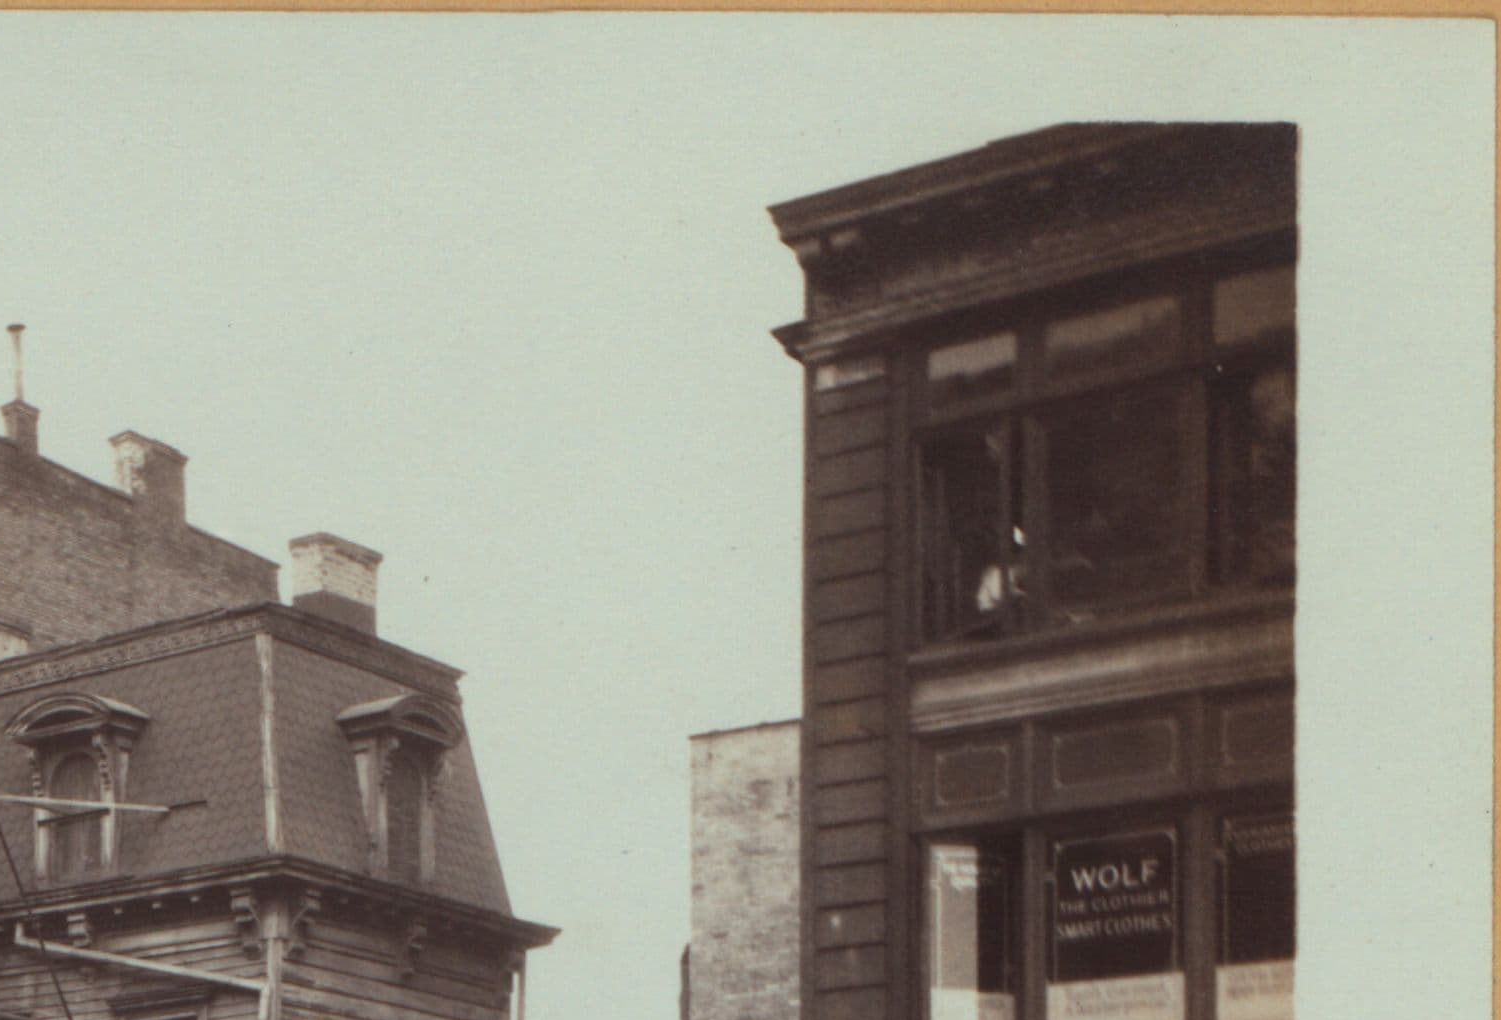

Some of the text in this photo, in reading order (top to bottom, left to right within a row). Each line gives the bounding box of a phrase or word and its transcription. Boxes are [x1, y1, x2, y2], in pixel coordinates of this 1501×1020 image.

[1071, 859, 1160, 892] WOLF
[1059, 900, 1086, 914] THE
[1104, 914, 1173, 935] CLOTHES
